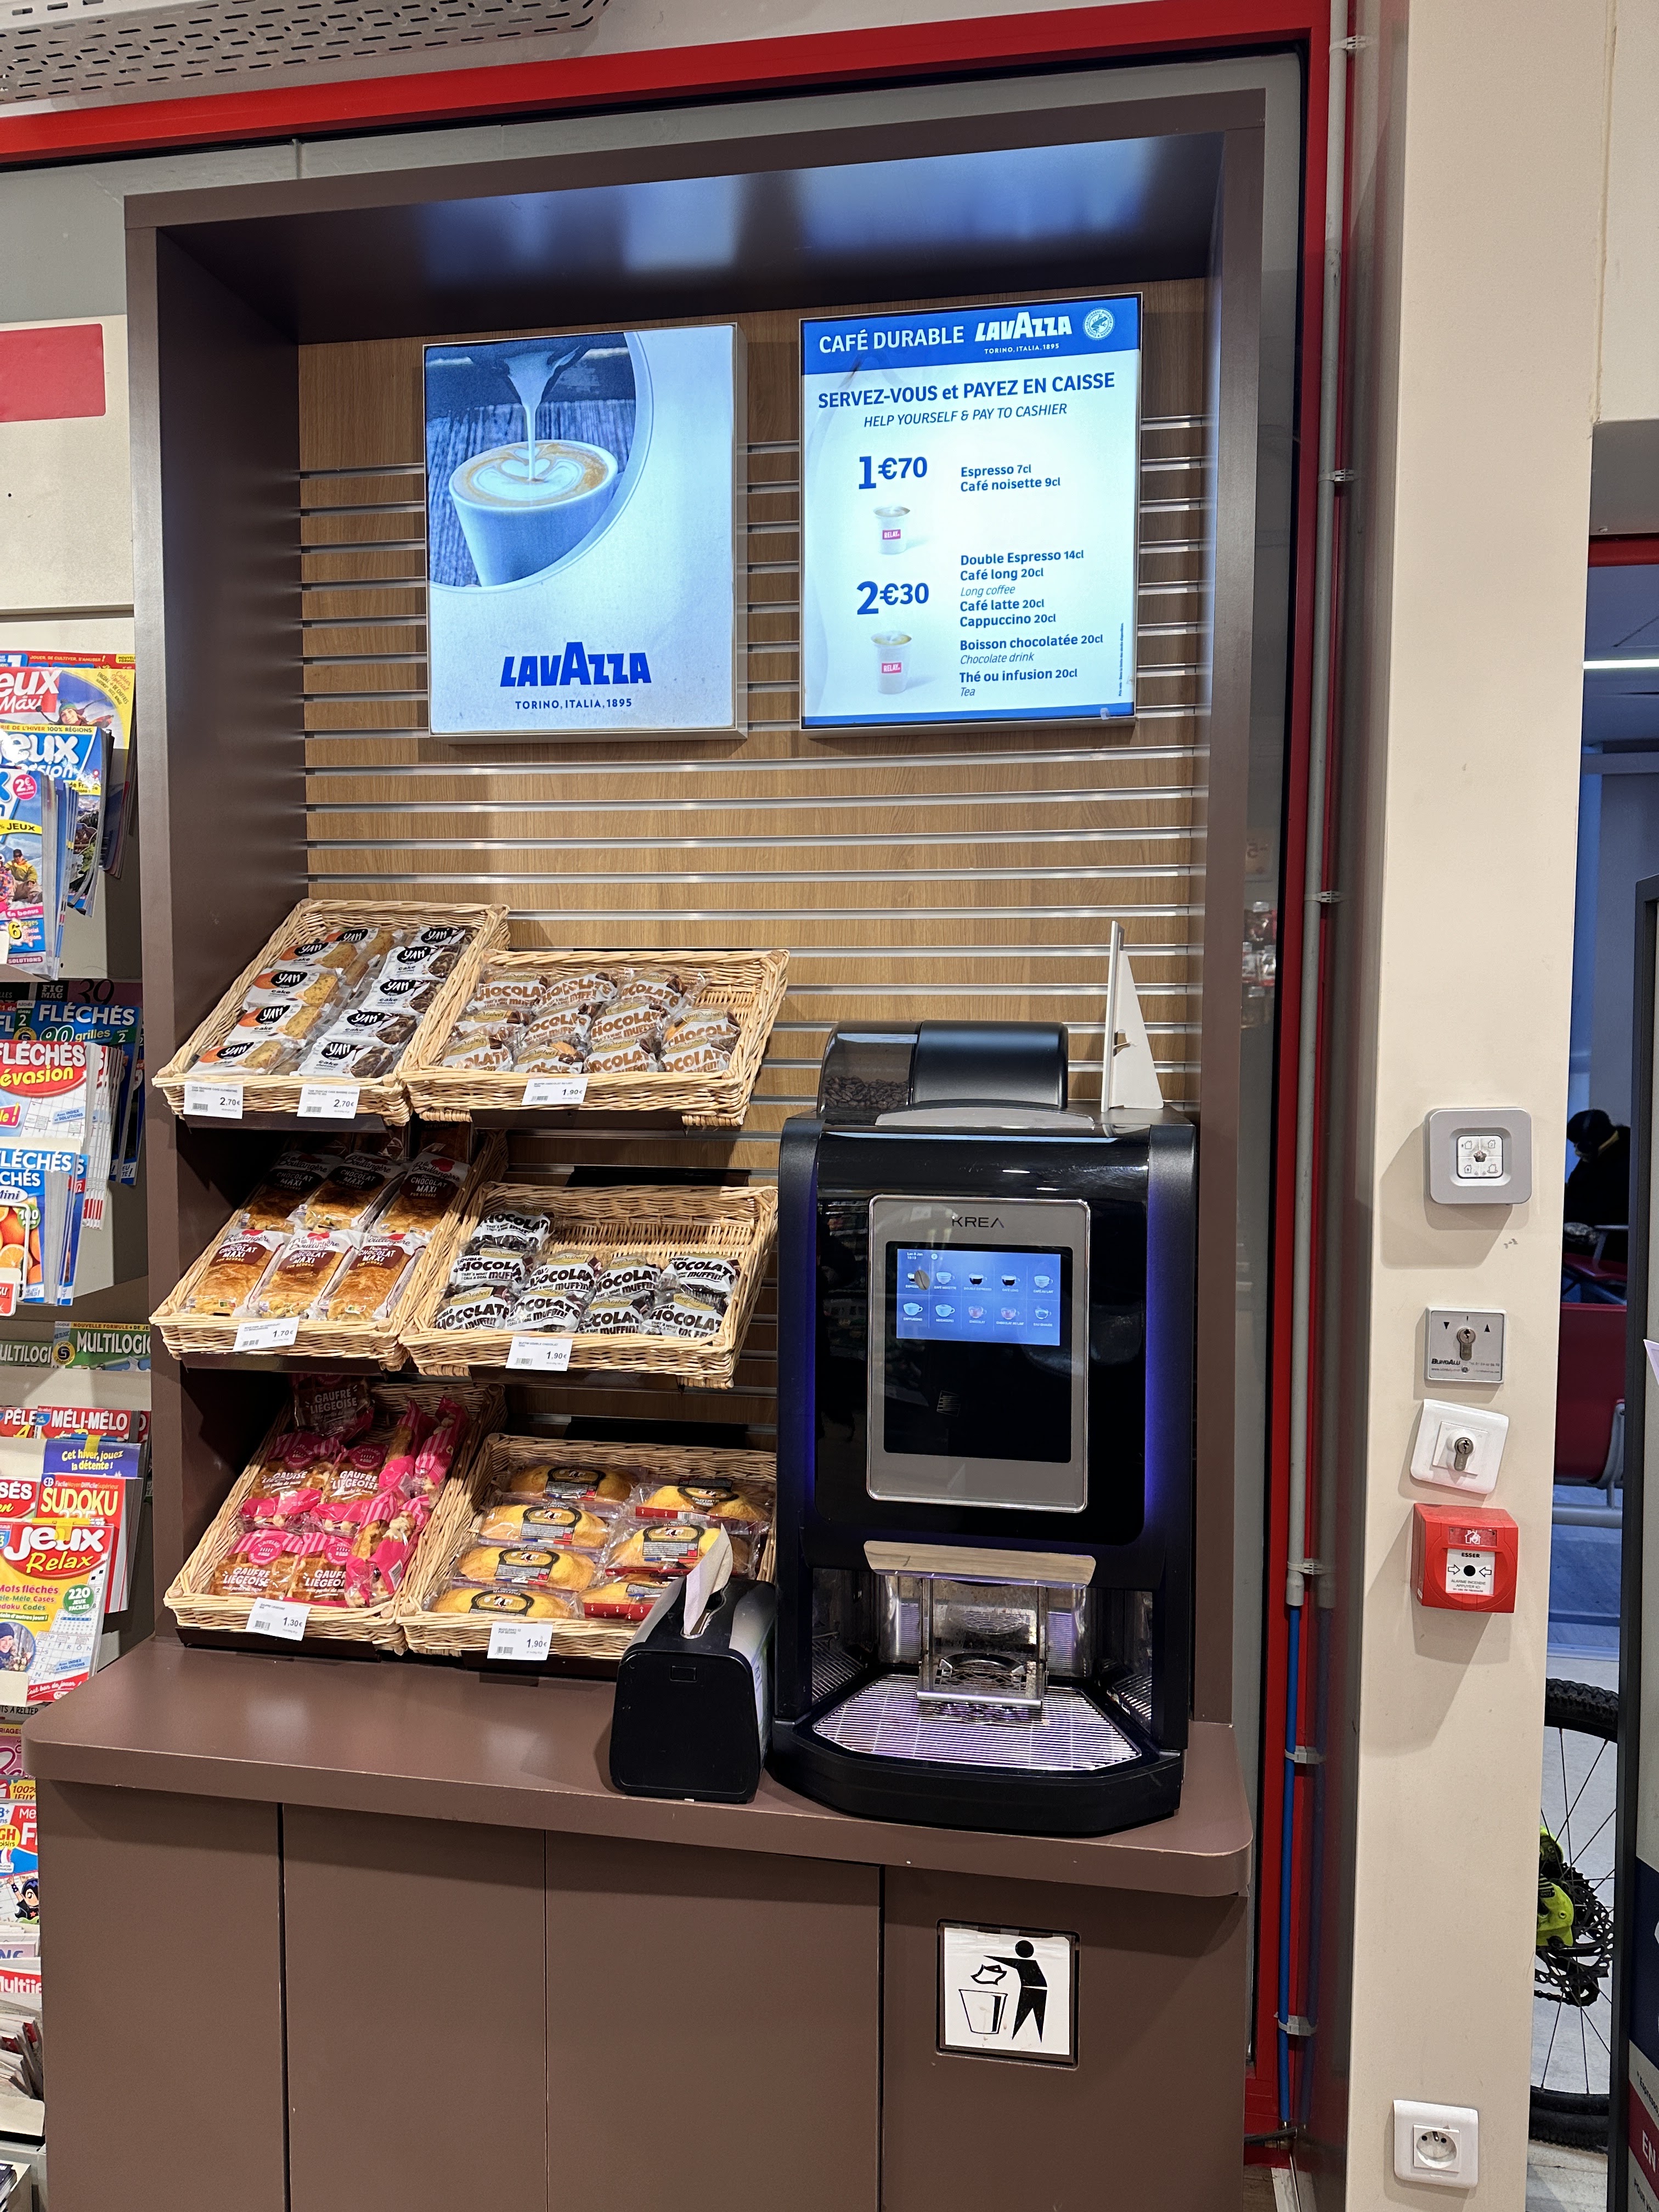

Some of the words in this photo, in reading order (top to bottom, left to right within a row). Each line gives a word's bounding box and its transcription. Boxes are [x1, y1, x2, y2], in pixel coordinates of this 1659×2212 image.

[975, 312, 1072, 342] LAVAZZA
[820, 329, 868, 353] CAFÉ
[873, 326, 964, 350] DURABLE
[819, 386, 938, 408] SERVEZ-VOUS
[942, 386, 958, 400] et
[964, 380, 1018, 398] PAYEZ
[1024, 378, 1048, 394] EN
[1052, 372, 1115, 391] CAISSE
[864, 414, 895, 427] HELP
[898, 410, 958, 425] YOURSELF
[961, 410, 969, 421] &
[973, 408, 994, 420] PAY
[998, 407, 1013, 419] TO
[1015, 403, 1067, 417] CASHIER
[961, 465, 1014, 479] Espresso
[1017, 464, 1031, 474] 7cl
[961, 478, 989, 492] Café
[991, 478, 1042, 490] noisette
[1045, 477, 1061, 488] 9cl
[961, 554, 1004, 566] Double
[1007, 551, 1061, 565] Espresso
[1064, 550, 1084, 560] 14cl
[960, 569, 988, 581] Café
[991, 569, 1018, 581] long
[1021, 568, 1044, 578] 20cl
[961, 587, 984, 597] Long
[986, 585, 1015, 595] coffee
[960, 600, 988, 612] Café
[991, 600, 1020, 610] latte
[1022, 599, 1045, 608] 20cl
[960, 614, 1031, 628] Cappuccino
[1034, 614, 1056, 623] 20cl
[960, 640, 1007, 650] Boisson
[1009, 634, 1078, 648] chocolatée
[1081, 634, 1103, 644] 20cl
[500, 641, 652, 687] LAVAZZA
[961, 653, 1007, 664] Chocolate
[1009, 652, 1034, 662] drink
[960, 671, 981, 682] Thé
[984, 673, 999, 681] ou
[1002, 669, 1052, 681] infusion
[1055, 669, 1077, 678] 20cl
[961, 687, 975, 697] Tea
[607, 698, 631, 708] 1895
[7, 823, 35, 831] JEUX
[18, 1014, 26, 1026] 2
[38, 1001, 135, 1026] FLÉCHÉS
[1, 1064, 74, 1086] évasion
[410, 1177, 448, 1188] CHOCOLAT
[219, 1246, 257, 1254] CHOCOLAT
[290, 1251, 326, 1261] CHOCOLAT
[358, 1249, 396, 1258] CHOCOLAT
[52, 1409, 127, 1431] MÉLI-MÉLO
[62, 1451, 76, 1461] Cet
[100, 1450, 123, 1462] jouez
[71, 1462, 78, 1470] la
[78, 1460, 109, 1471] détente
[340, 1470, 377, 1482] GAUFRE
[41, 1487, 118, 1516] SUDOKU
[26, 1552, 93, 1573] Relax
[233, 1566, 271, 1578] GAUFRE
[69, 1587, 90, 1600] 220
